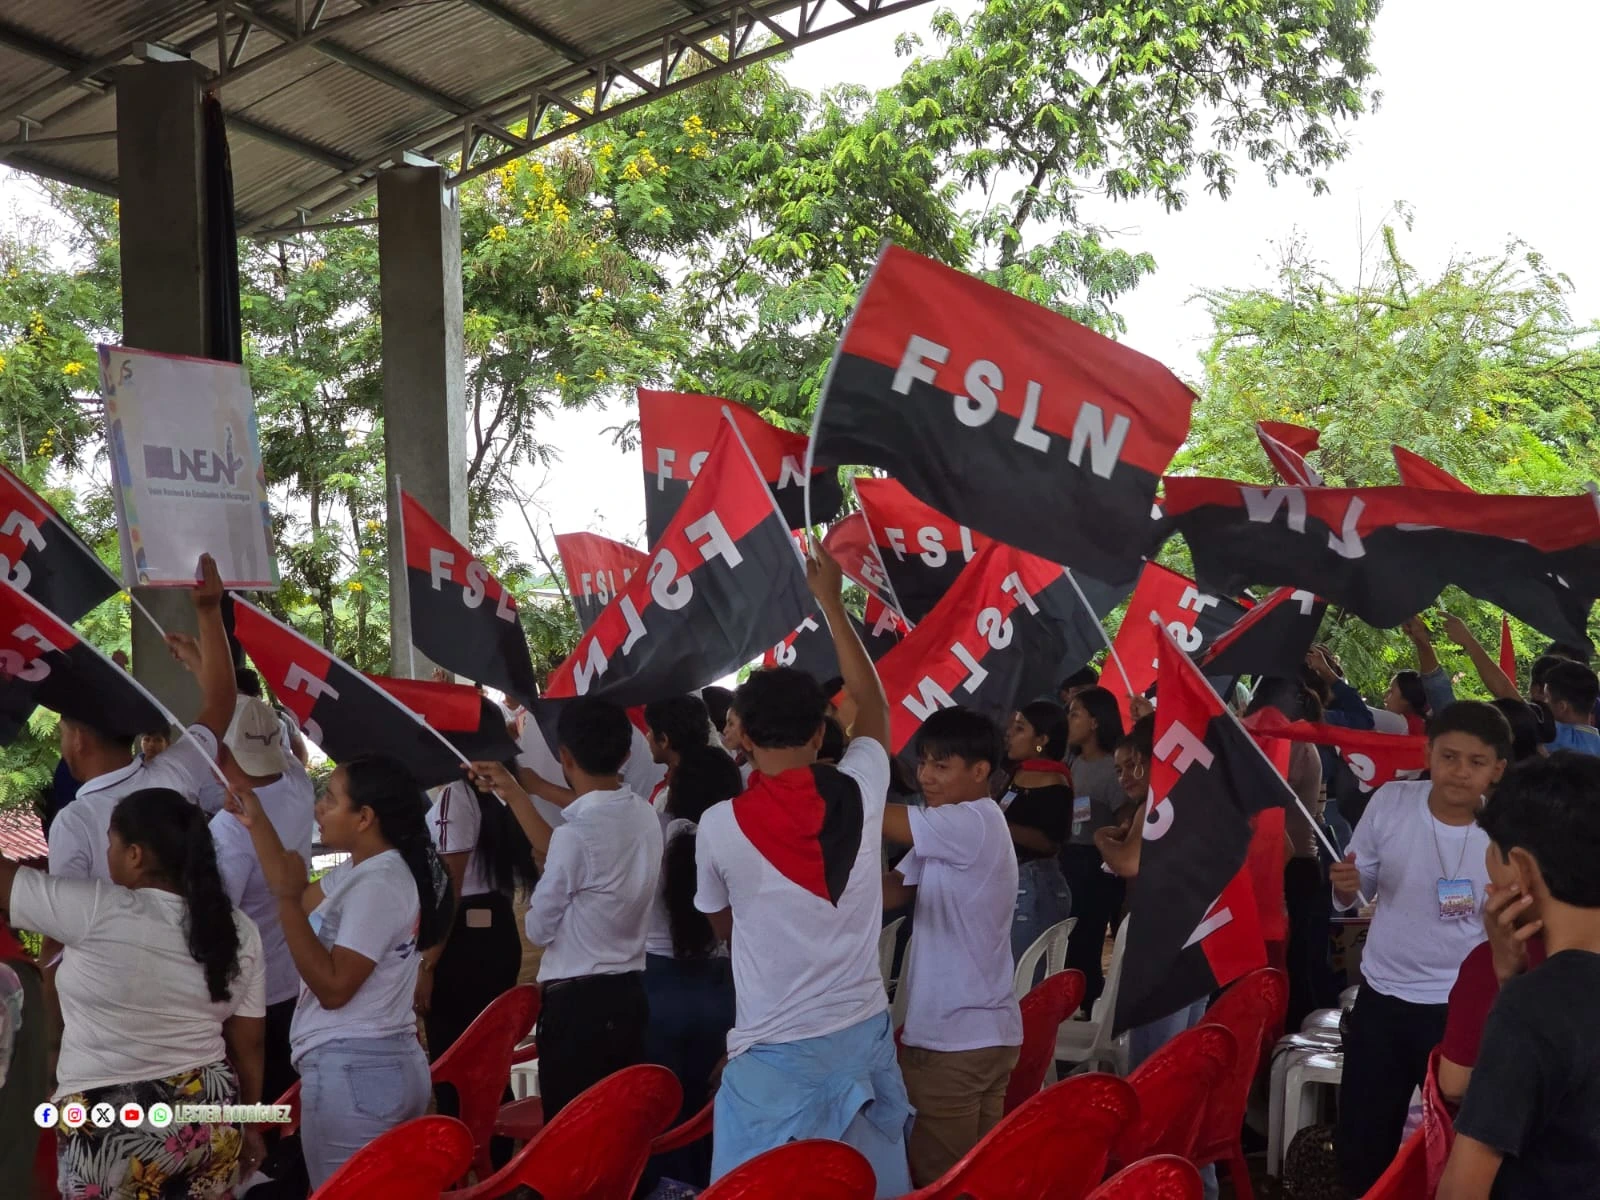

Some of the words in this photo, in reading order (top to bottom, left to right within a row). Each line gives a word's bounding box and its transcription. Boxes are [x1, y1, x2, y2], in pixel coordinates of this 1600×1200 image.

[891, 334, 1131, 480] FSLN
[145, 443, 243, 485] UNEN
[884, 525, 977, 569] FSL
[429, 547, 517, 624] FSL
